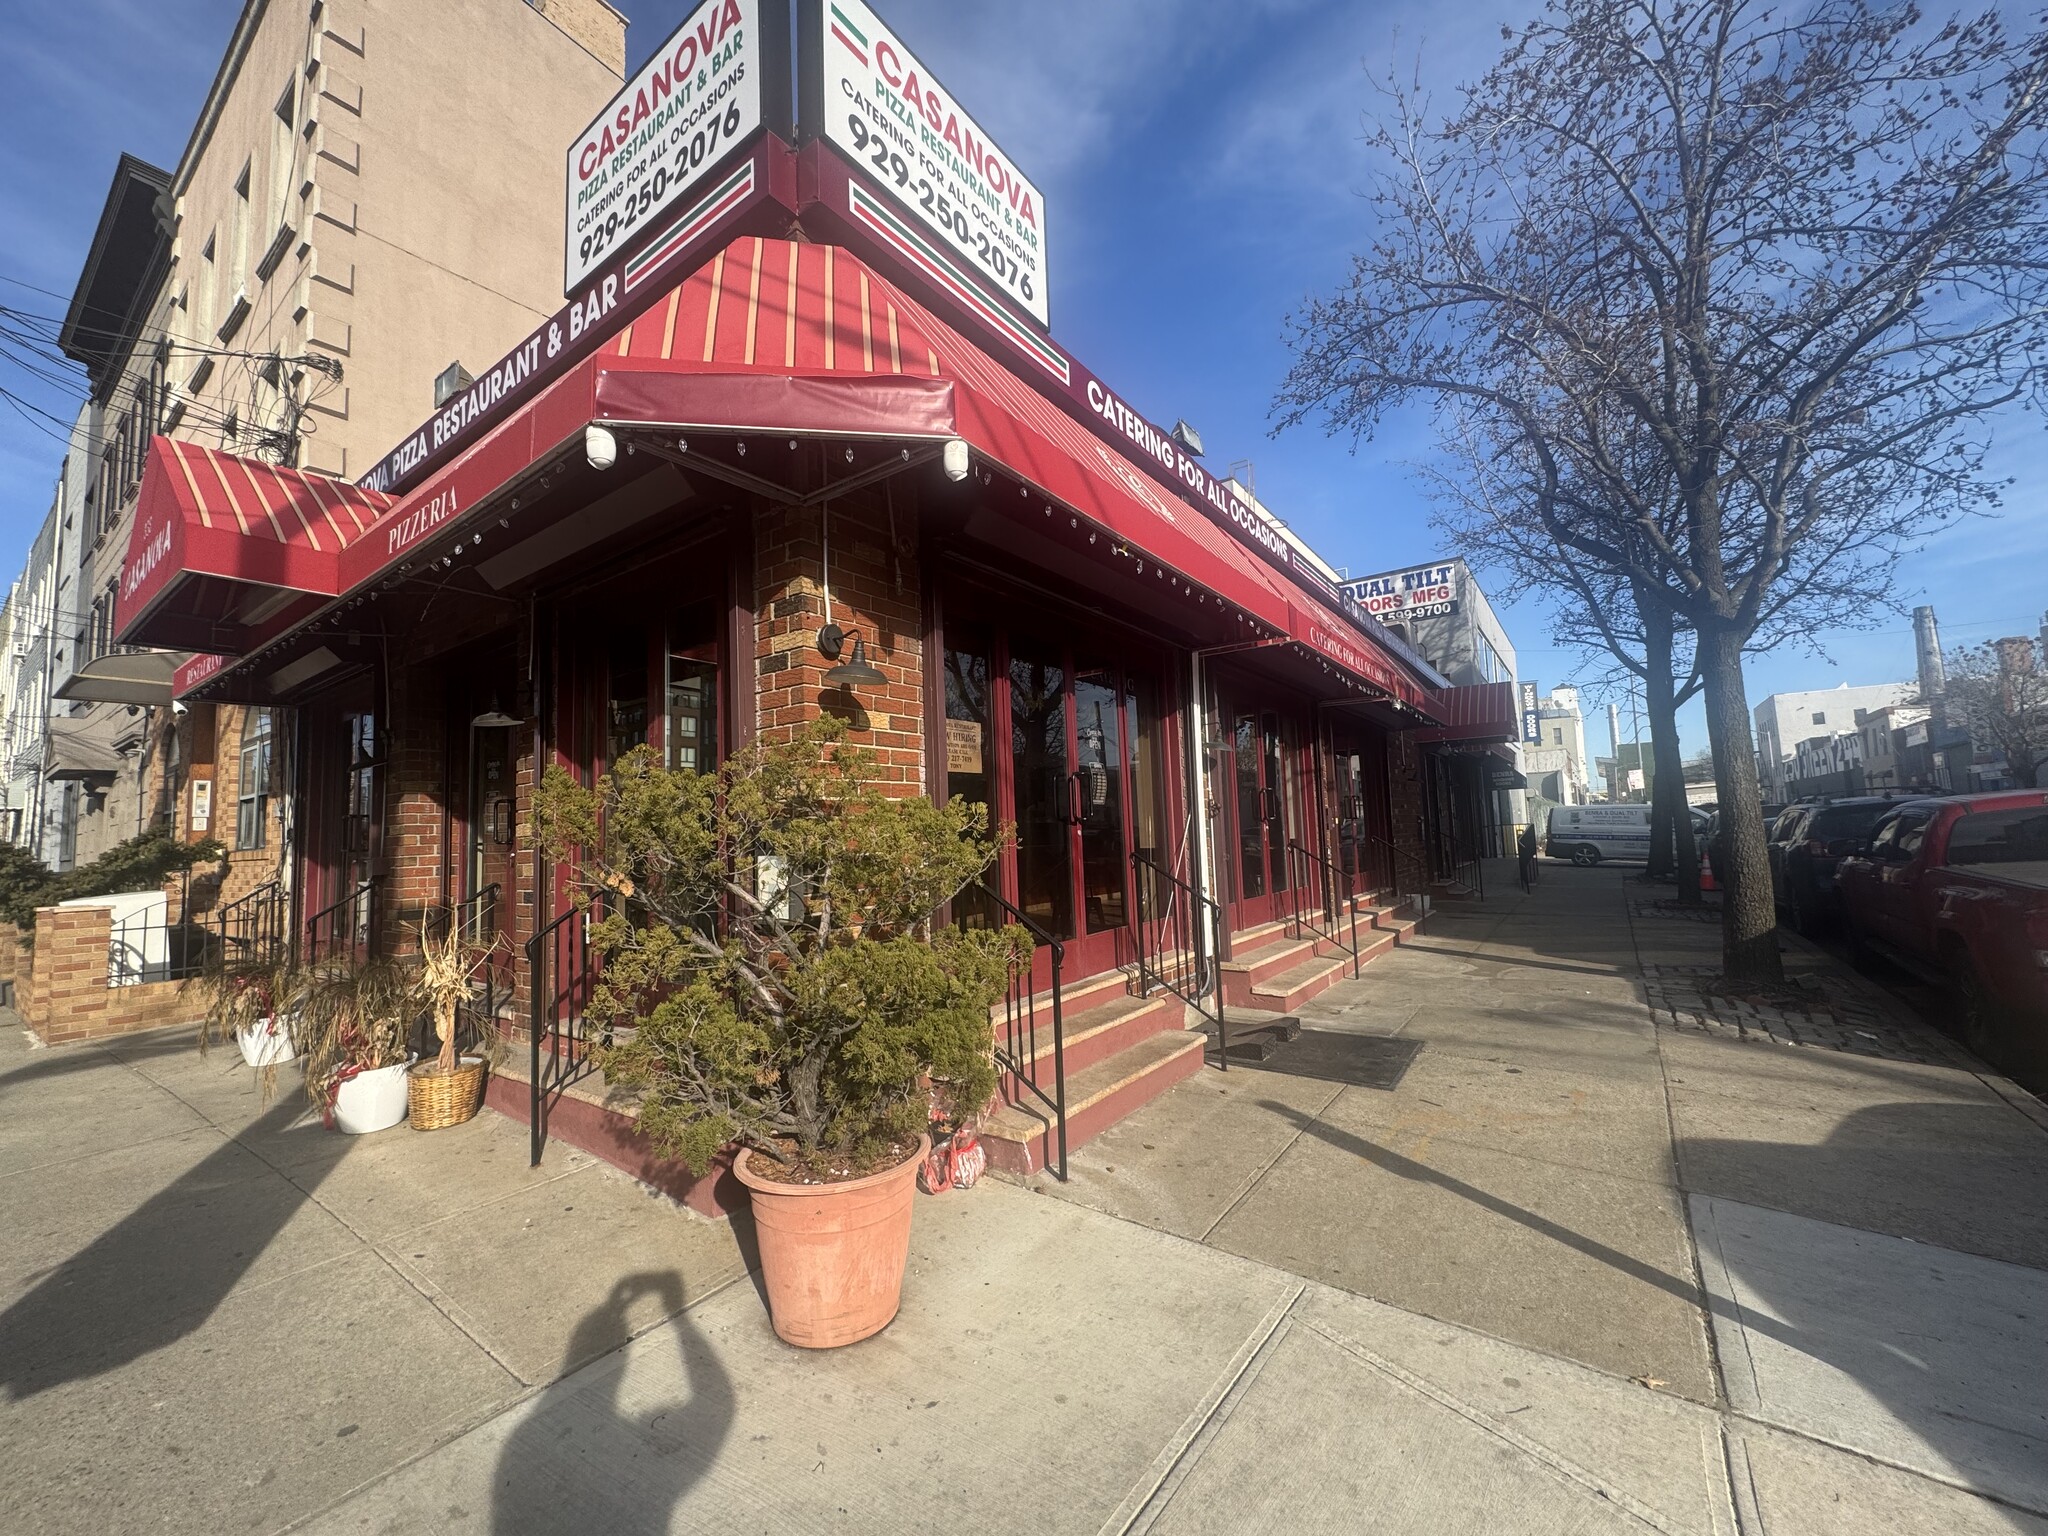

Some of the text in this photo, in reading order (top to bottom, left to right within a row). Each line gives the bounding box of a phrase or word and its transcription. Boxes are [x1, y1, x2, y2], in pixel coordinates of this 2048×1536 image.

[577, 62, 745, 233] CATERING FOR ALL OCCASIONS
[578, 29, 743, 210] PIZZA RESTAURANT & BAR
[579, 0, 742, 181] CASANOVA
[841, 77, 1036, 271] CATERING FOR ALL OCCASIONS
[875, 41, 1037, 230] CASANOVA
[875, 77, 1038, 252] PIZZA RESTAURANT & BAR
[579, 98, 741, 268] 929-250-2076
[848, 114, 1034, 301] 929-250-2076
[392, 432, 428, 482] PIZZA
[434, 335, 541, 449] RESTAURANT
[547, 321, 563, 358] &
[570, 273, 618, 342] BAR
[388, 485, 457, 555] PIZZERIA
[1087, 380, 1174, 469] CATERING
[1178, 453, 1205, 496] FOR
[1207, 480, 1228, 515] ALL
[1230, 499, 1288, 563] OCCASIONS
[1310, 627, 1342, 659] CATERING
[1343, 648, 1355, 667] FOR
[1340, 567, 1451, 600] DUAL TILT
[1412, 585, 1450, 605] MFG
[953, 732, 977, 743] HIRING
